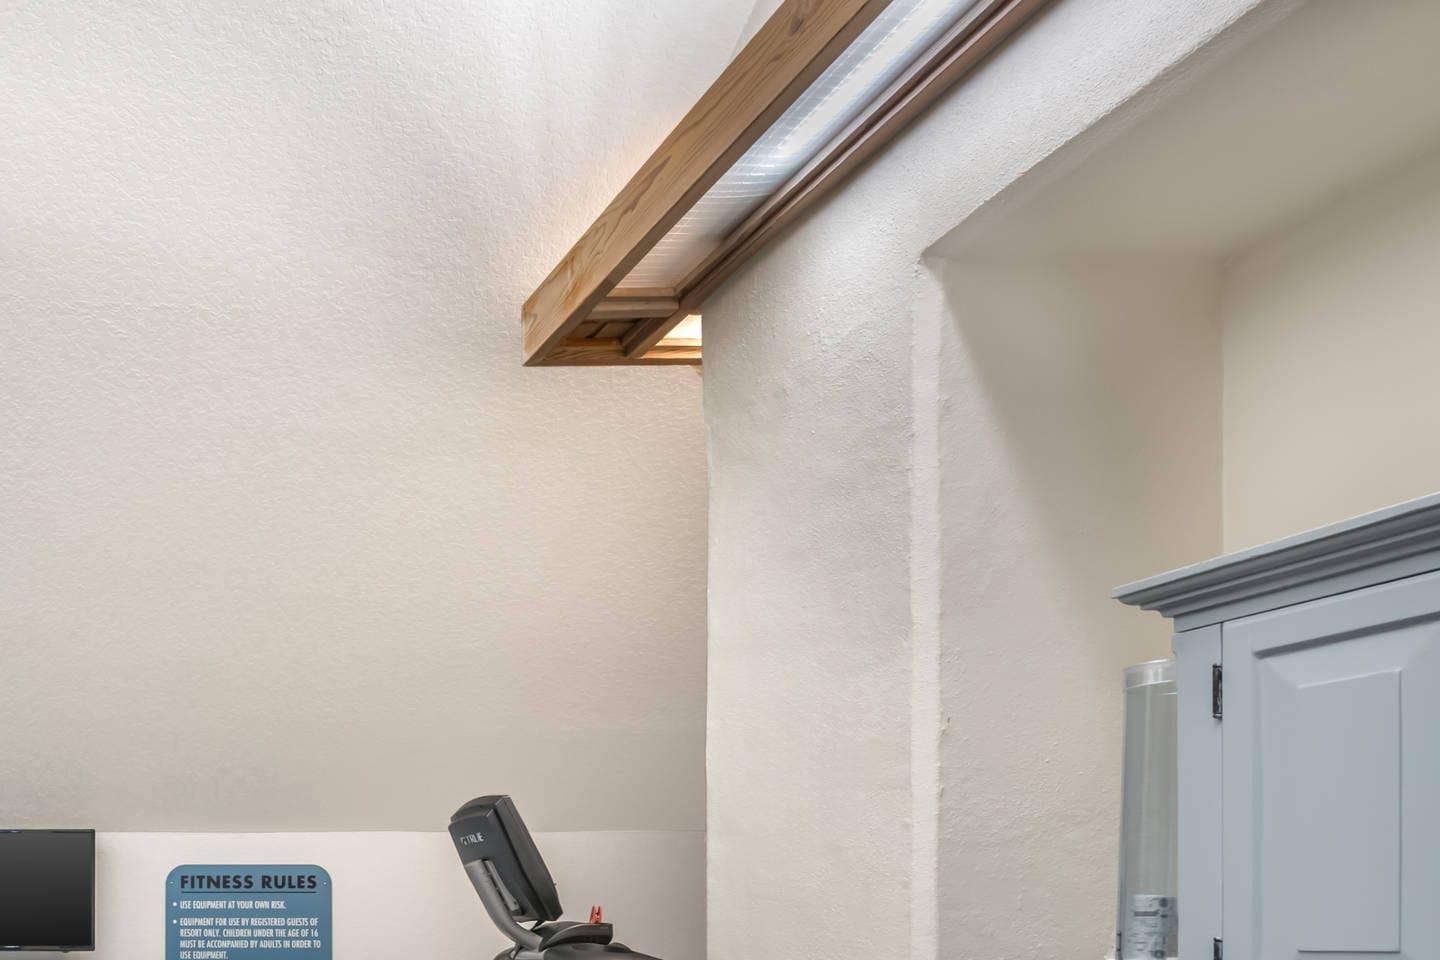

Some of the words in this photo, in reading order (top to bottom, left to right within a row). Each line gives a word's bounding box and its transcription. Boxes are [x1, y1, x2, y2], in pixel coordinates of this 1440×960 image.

[180, 875, 253, 888] FITNESS
[262, 875, 317, 888] RULES
[180, 901, 191, 909] USE
[193, 901, 227, 909] EQUIPMENT
[228, 901, 235, 909] AT
[237, 901, 253, 909] YOUR
[255, 901, 270, 909] OWN
[271, 901, 286, 909] RISK.
[180, 918, 214, 926] EQUIPMENT
[215, 918, 227, 926] FOR
[229, 918, 240, 926] USE
[242, 918, 249, 926] BY
[251, 918, 285, 926] REGISTERED
[287, 918, 308, 926] GUESTS
[310, 918, 318, 926] OF
[180, 929, 202, 937] RESORT
[204, 929, 221, 937] ONLY.
[223, 929, 252, 937] CHILDREN
[253, 929, 273, 937] UNDER
[275, 929, 286, 937] THE
[288, 929, 299, 937] AGE
[301, 929, 309, 937] OF
[311, 929, 318, 937] 16
[180, 940, 196, 948] MUST
[198, 940, 205, 948] BE
[207, 940, 248, 948] ACCOMPANIED
[250, 940, 258, 948] BY
[259, 940, 282, 948] ADULTS
[283, 940, 290, 948] IN
[292, 940, 312, 948] ORDER
[313, 940, 321, 948] TO
[180, 951, 191, 959] USE
[193, 951, 228, 959] EQUIPMENT.
